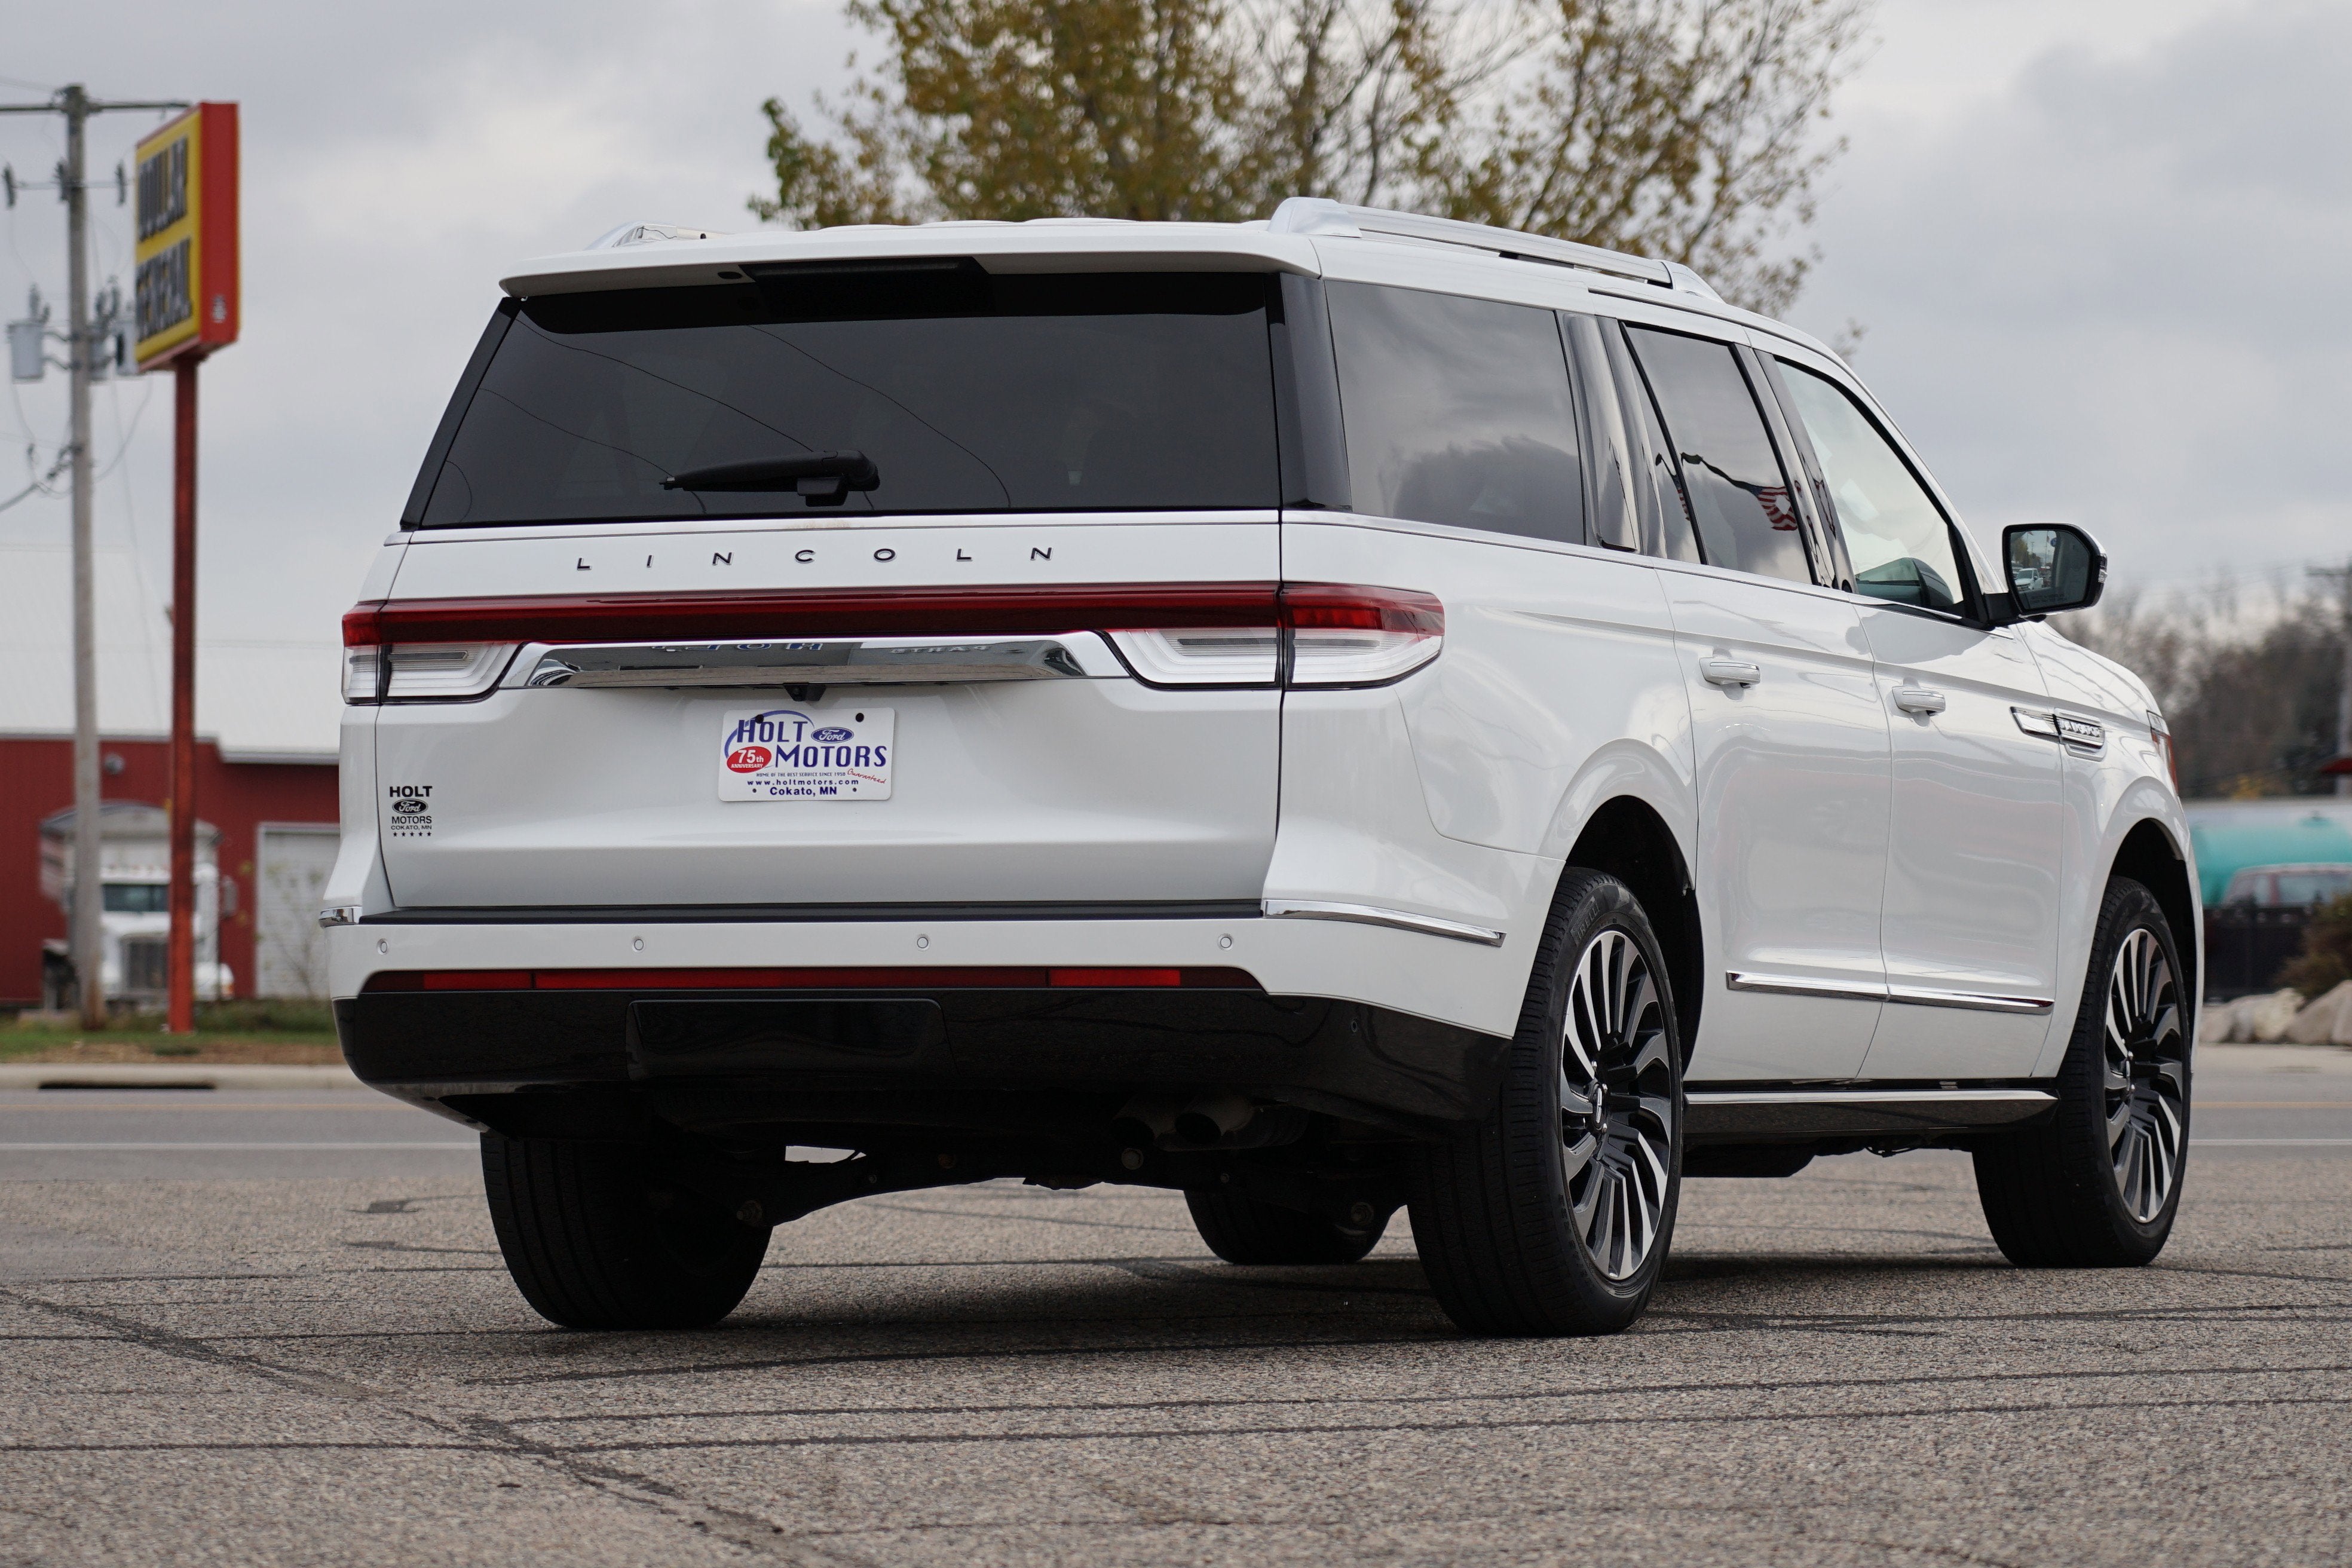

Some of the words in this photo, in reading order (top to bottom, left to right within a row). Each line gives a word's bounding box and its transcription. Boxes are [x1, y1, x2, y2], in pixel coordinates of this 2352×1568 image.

[577, 547, 1053, 571] LINCOLN
[737, 719, 808, 743] HOLT
[818, 729, 845, 741] Ford
[737, 749, 764, 763] 75th
[775, 744, 887, 768] MOTORS
[847, 768, 887, 785] Guaranteed
[390, 786, 433, 797] HOLT
[770, 786, 816, 797] Cokato,
[819, 786, 837, 795] MN
[399, 801, 422, 812] Ford
[391, 816, 432, 824] MOTORS
